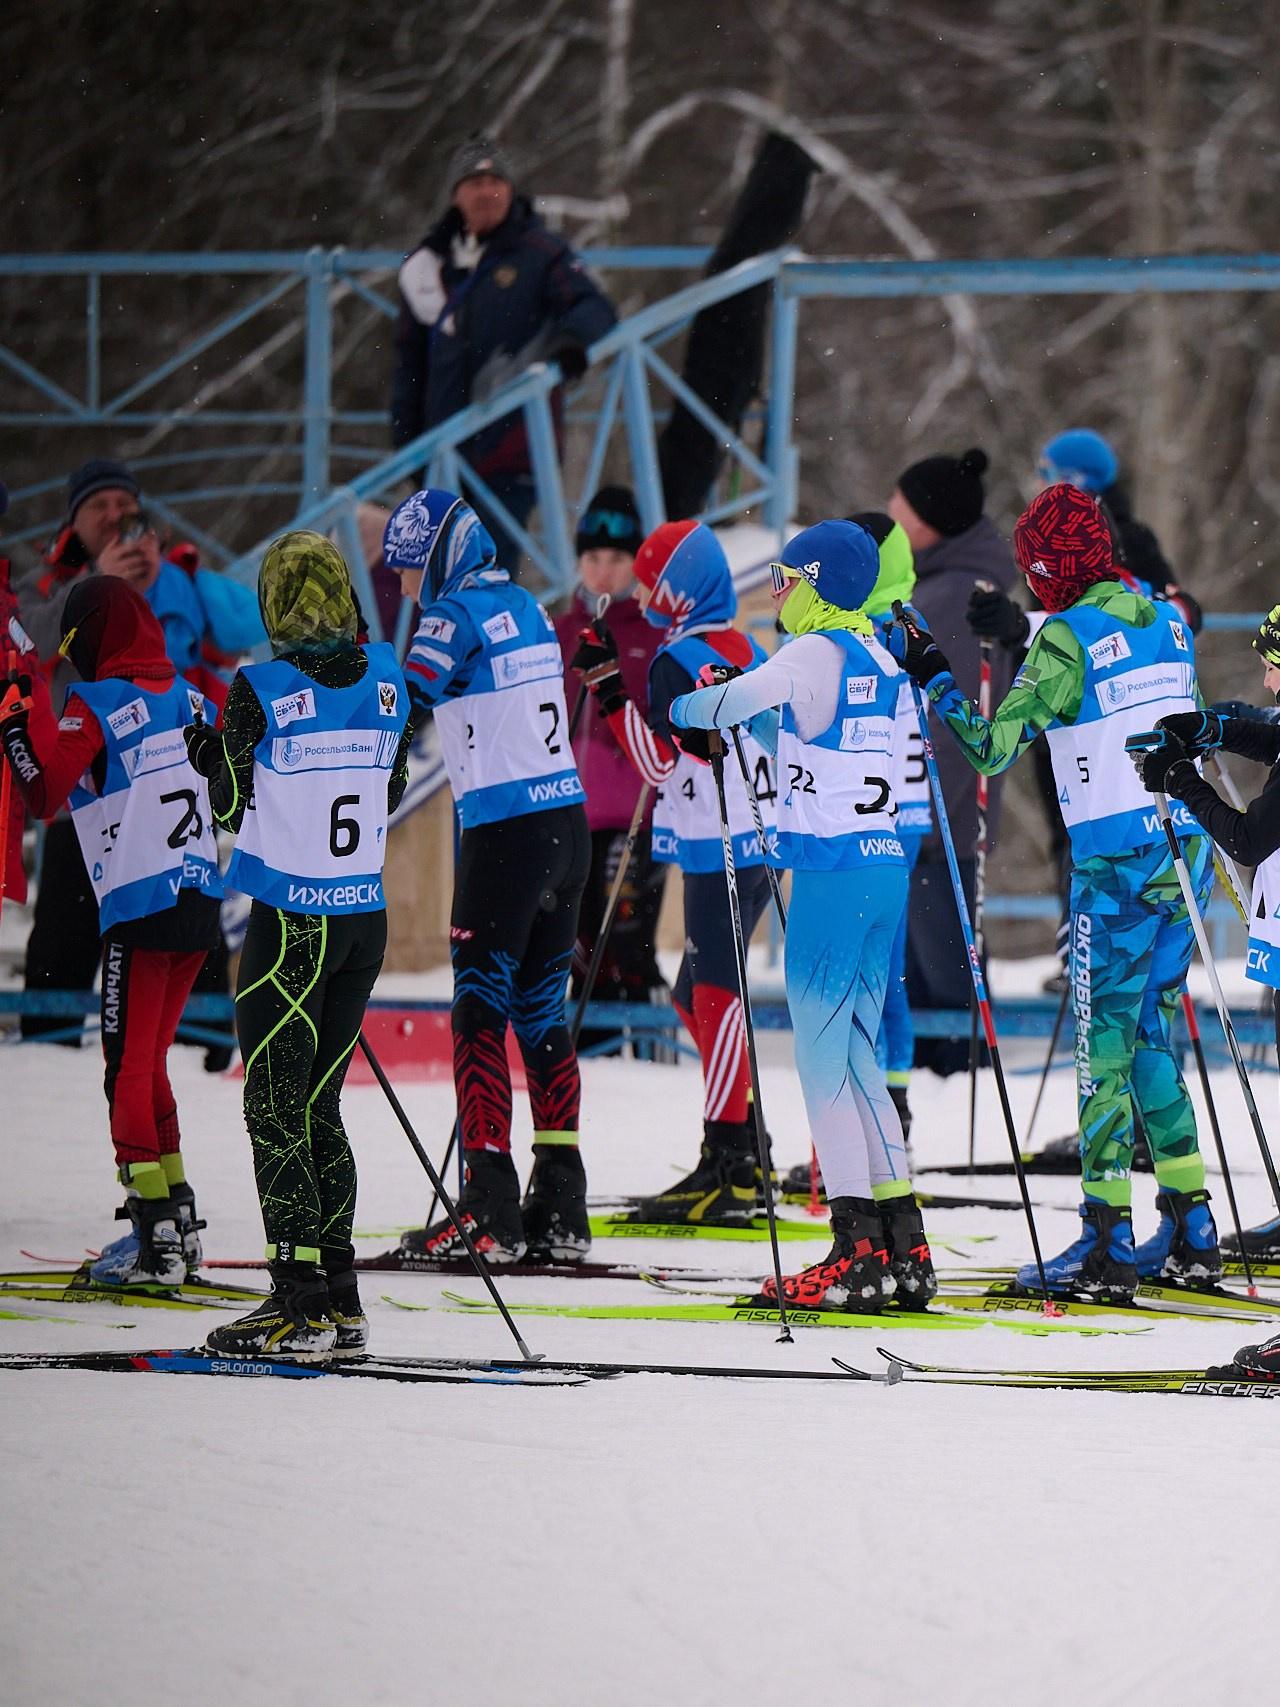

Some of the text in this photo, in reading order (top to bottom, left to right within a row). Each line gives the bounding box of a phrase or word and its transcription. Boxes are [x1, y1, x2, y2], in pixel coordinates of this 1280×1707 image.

[1092, 645, 1111, 661] СБР
[275, 703, 296, 717] СБР
[539, 702, 561, 755] 2
[1076, 756, 1090, 784] 5
[787, 763, 817, 795] 22
[682, 777, 696, 800] 4
[1059, 785, 1071, 806] 4
[329, 794, 361, 858] 6
[288, 883, 380, 907] ИЖЕВСК
[611, 1224, 698, 1238] FISCHER
[401, 1261, 442, 1271] ATOMIC
[62, 1291, 125, 1306] FISCHER
[981, 1298, 1069, 1314] FISCHR
[734, 1309, 821, 1324] FISCHER
[210, 1361, 273, 1375] salomon
